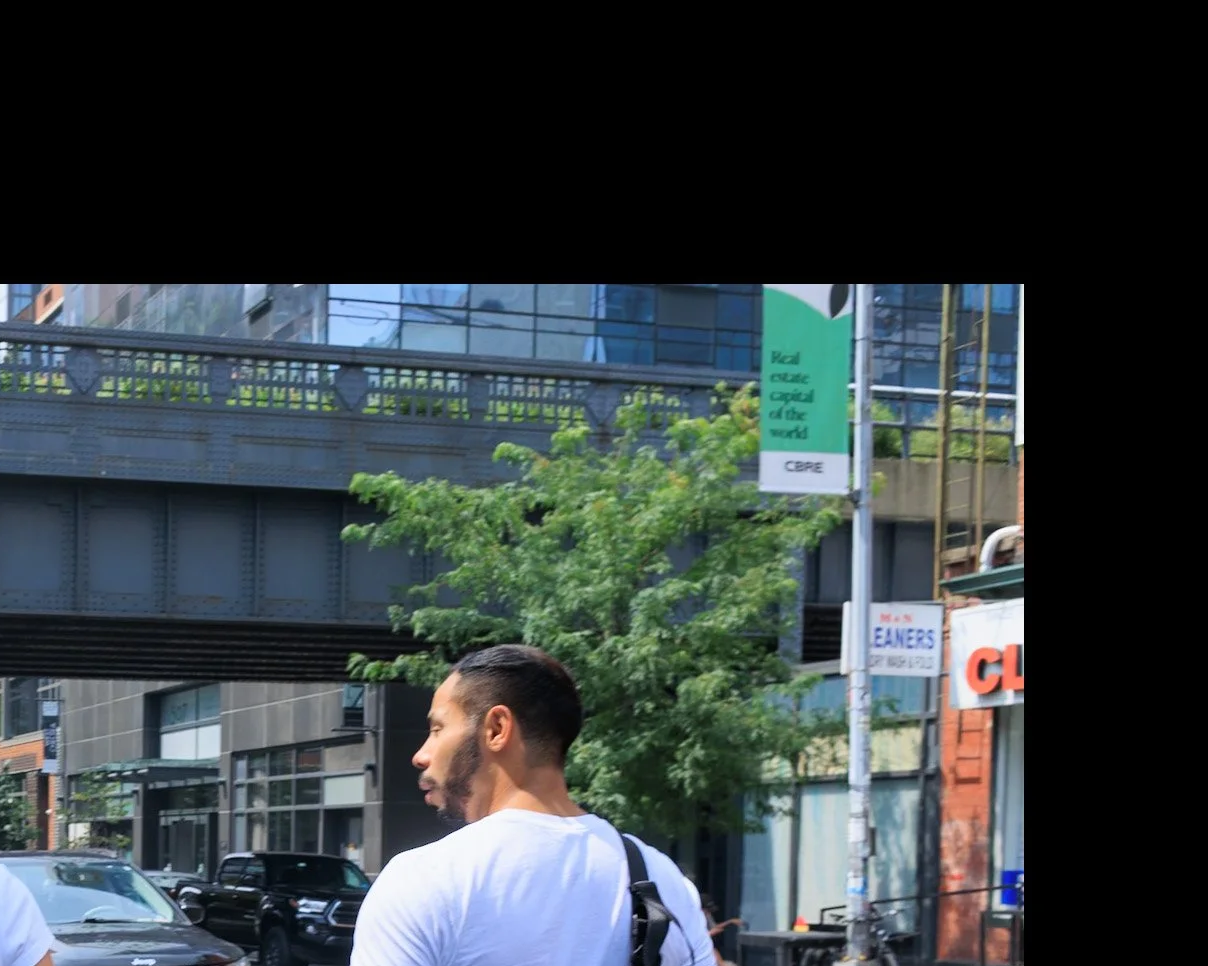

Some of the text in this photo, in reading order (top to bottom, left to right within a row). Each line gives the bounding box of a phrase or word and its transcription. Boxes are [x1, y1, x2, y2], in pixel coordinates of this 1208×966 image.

[771, 351, 800, 365] Real
[770, 372, 810, 385] estate
[770, 388, 815, 404] capital
[769, 404, 807, 421] of the
[769, 425, 808, 440] world
[784, 460, 824, 474] CBRE
[872, 627, 934, 649] EANERS
